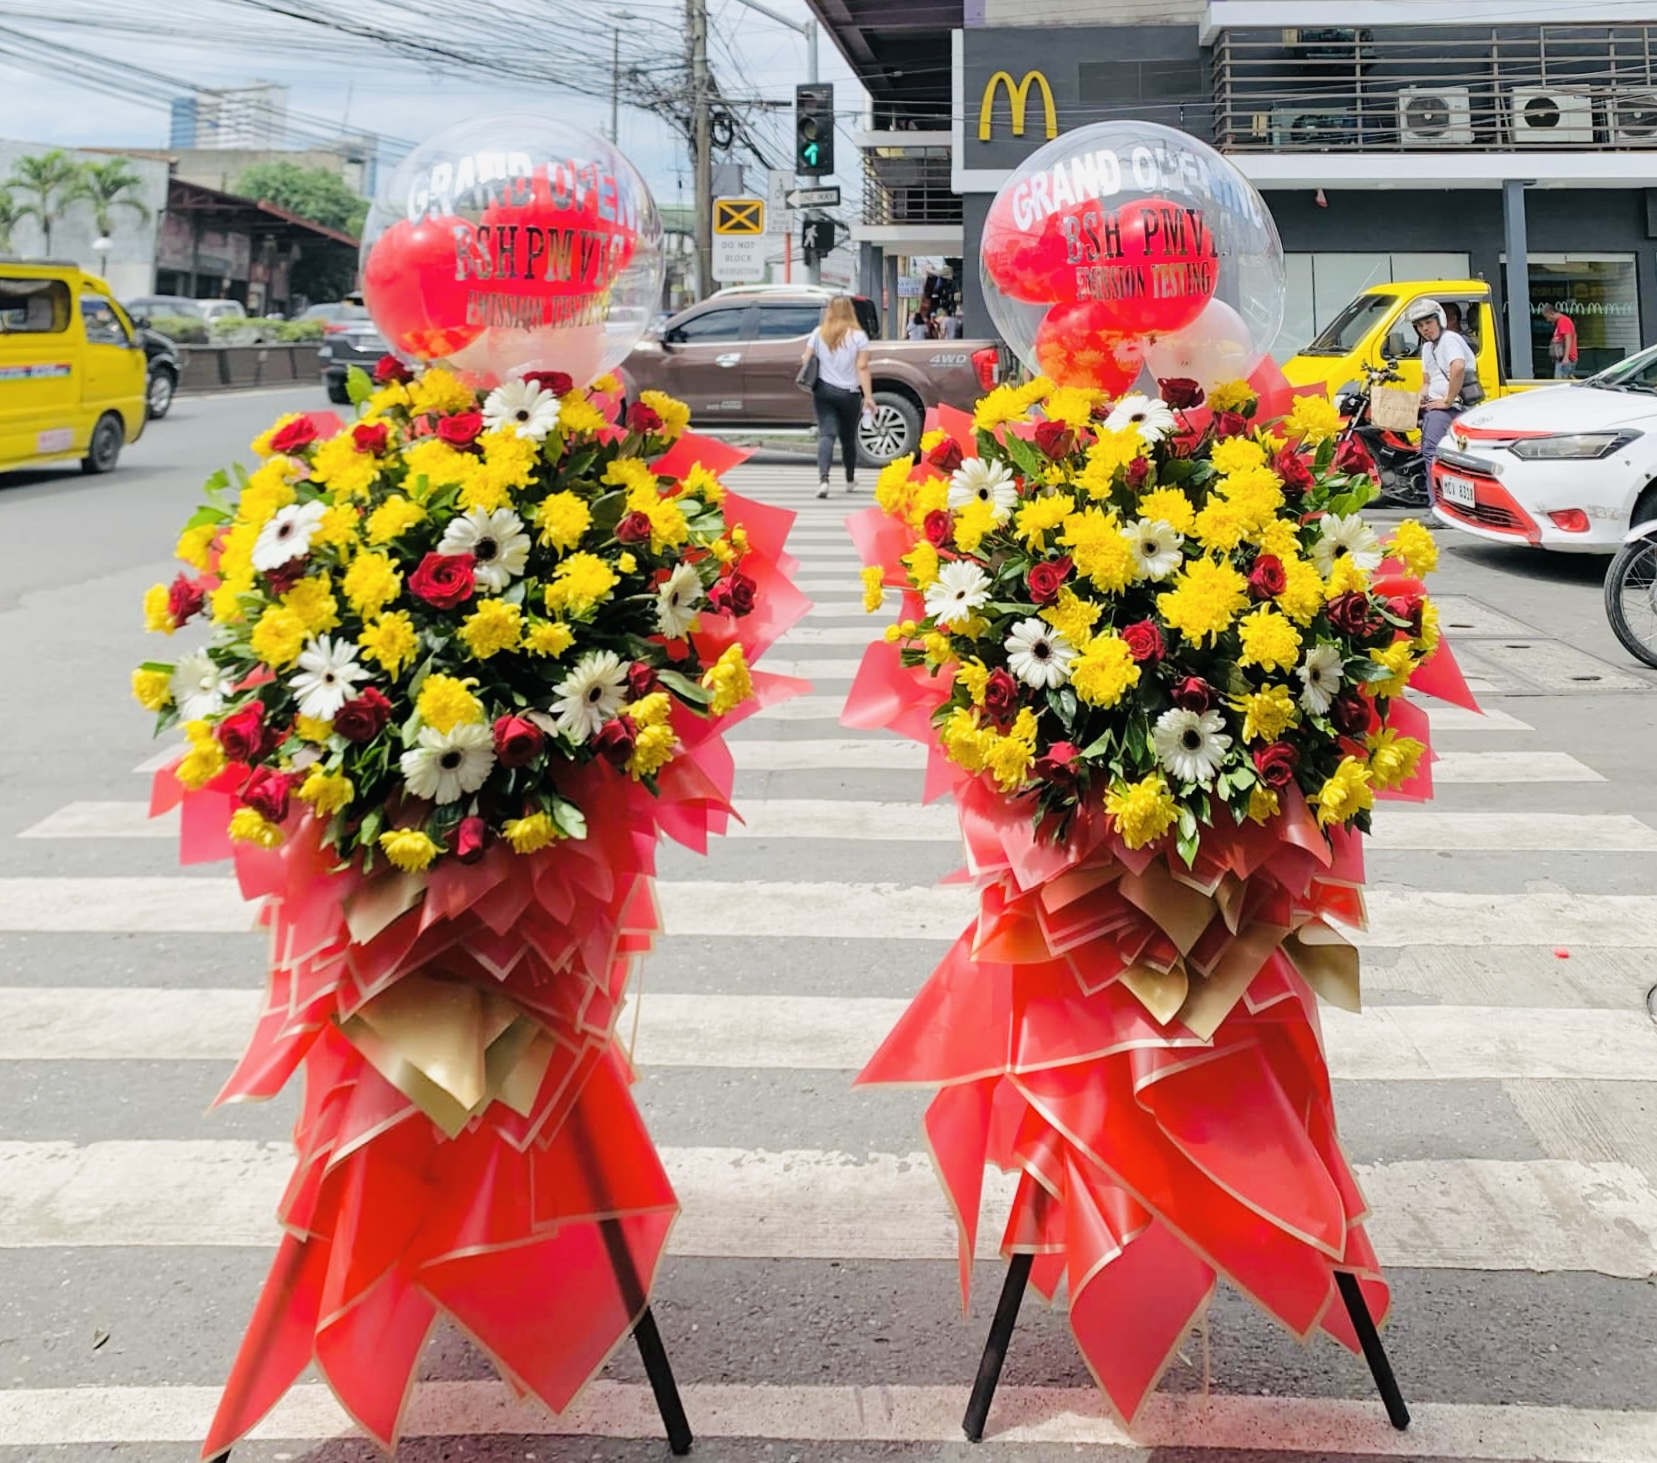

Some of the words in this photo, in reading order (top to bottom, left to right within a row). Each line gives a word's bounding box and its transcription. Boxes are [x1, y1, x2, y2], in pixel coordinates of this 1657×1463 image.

[407, 151, 535, 226] GRAND
[800, 194, 815, 202] ONE
[818, 193, 835, 201] WAY
[1012, 148, 1121, 231] GRAND
[453, 225, 518, 281] BSH
[721, 241, 735, 249] DO
[737, 241, 755, 249] NOT
[1064, 206, 1124, 264] BSH
[724, 254, 752, 262] BLOCK
[1076, 264, 1146, 300] EMISSION
[1152, 262, 1211, 299] TESTING
[466, 290, 545, 329] EMISSION
[929, 354, 967, 364] 4WD
